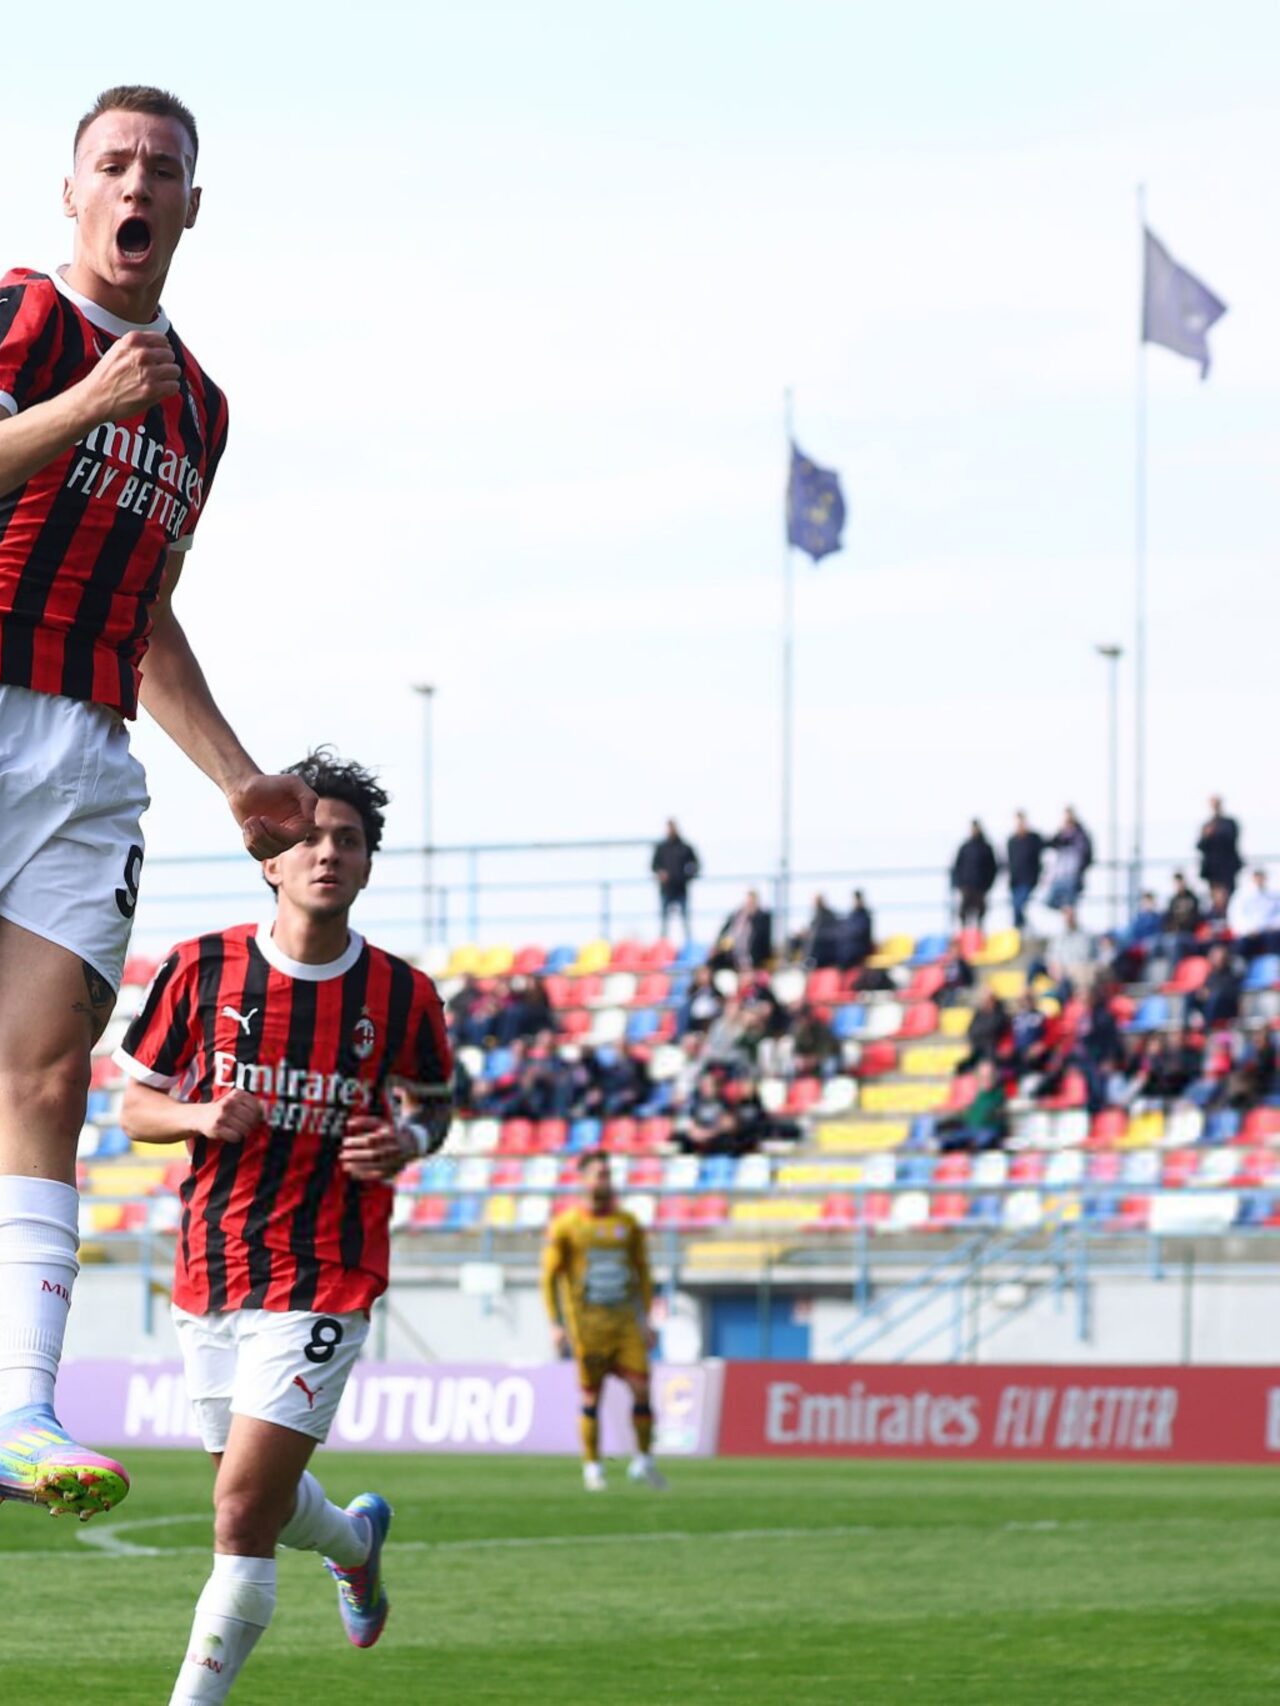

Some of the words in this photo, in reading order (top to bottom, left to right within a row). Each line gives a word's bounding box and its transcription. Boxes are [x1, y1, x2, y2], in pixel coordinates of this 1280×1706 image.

[66, 456, 119, 500] FLY
[116, 475, 188, 540] BETTER
[74, 421, 204, 511] mirates
[304, 1318, 343, 1364] 8
[336, 1375, 535, 1445] UTURO
[765, 1383, 980, 1447] Emirates
[993, 1386, 1055, 1448] FLY
[1053, 1387, 1178, 1450] BETTER
